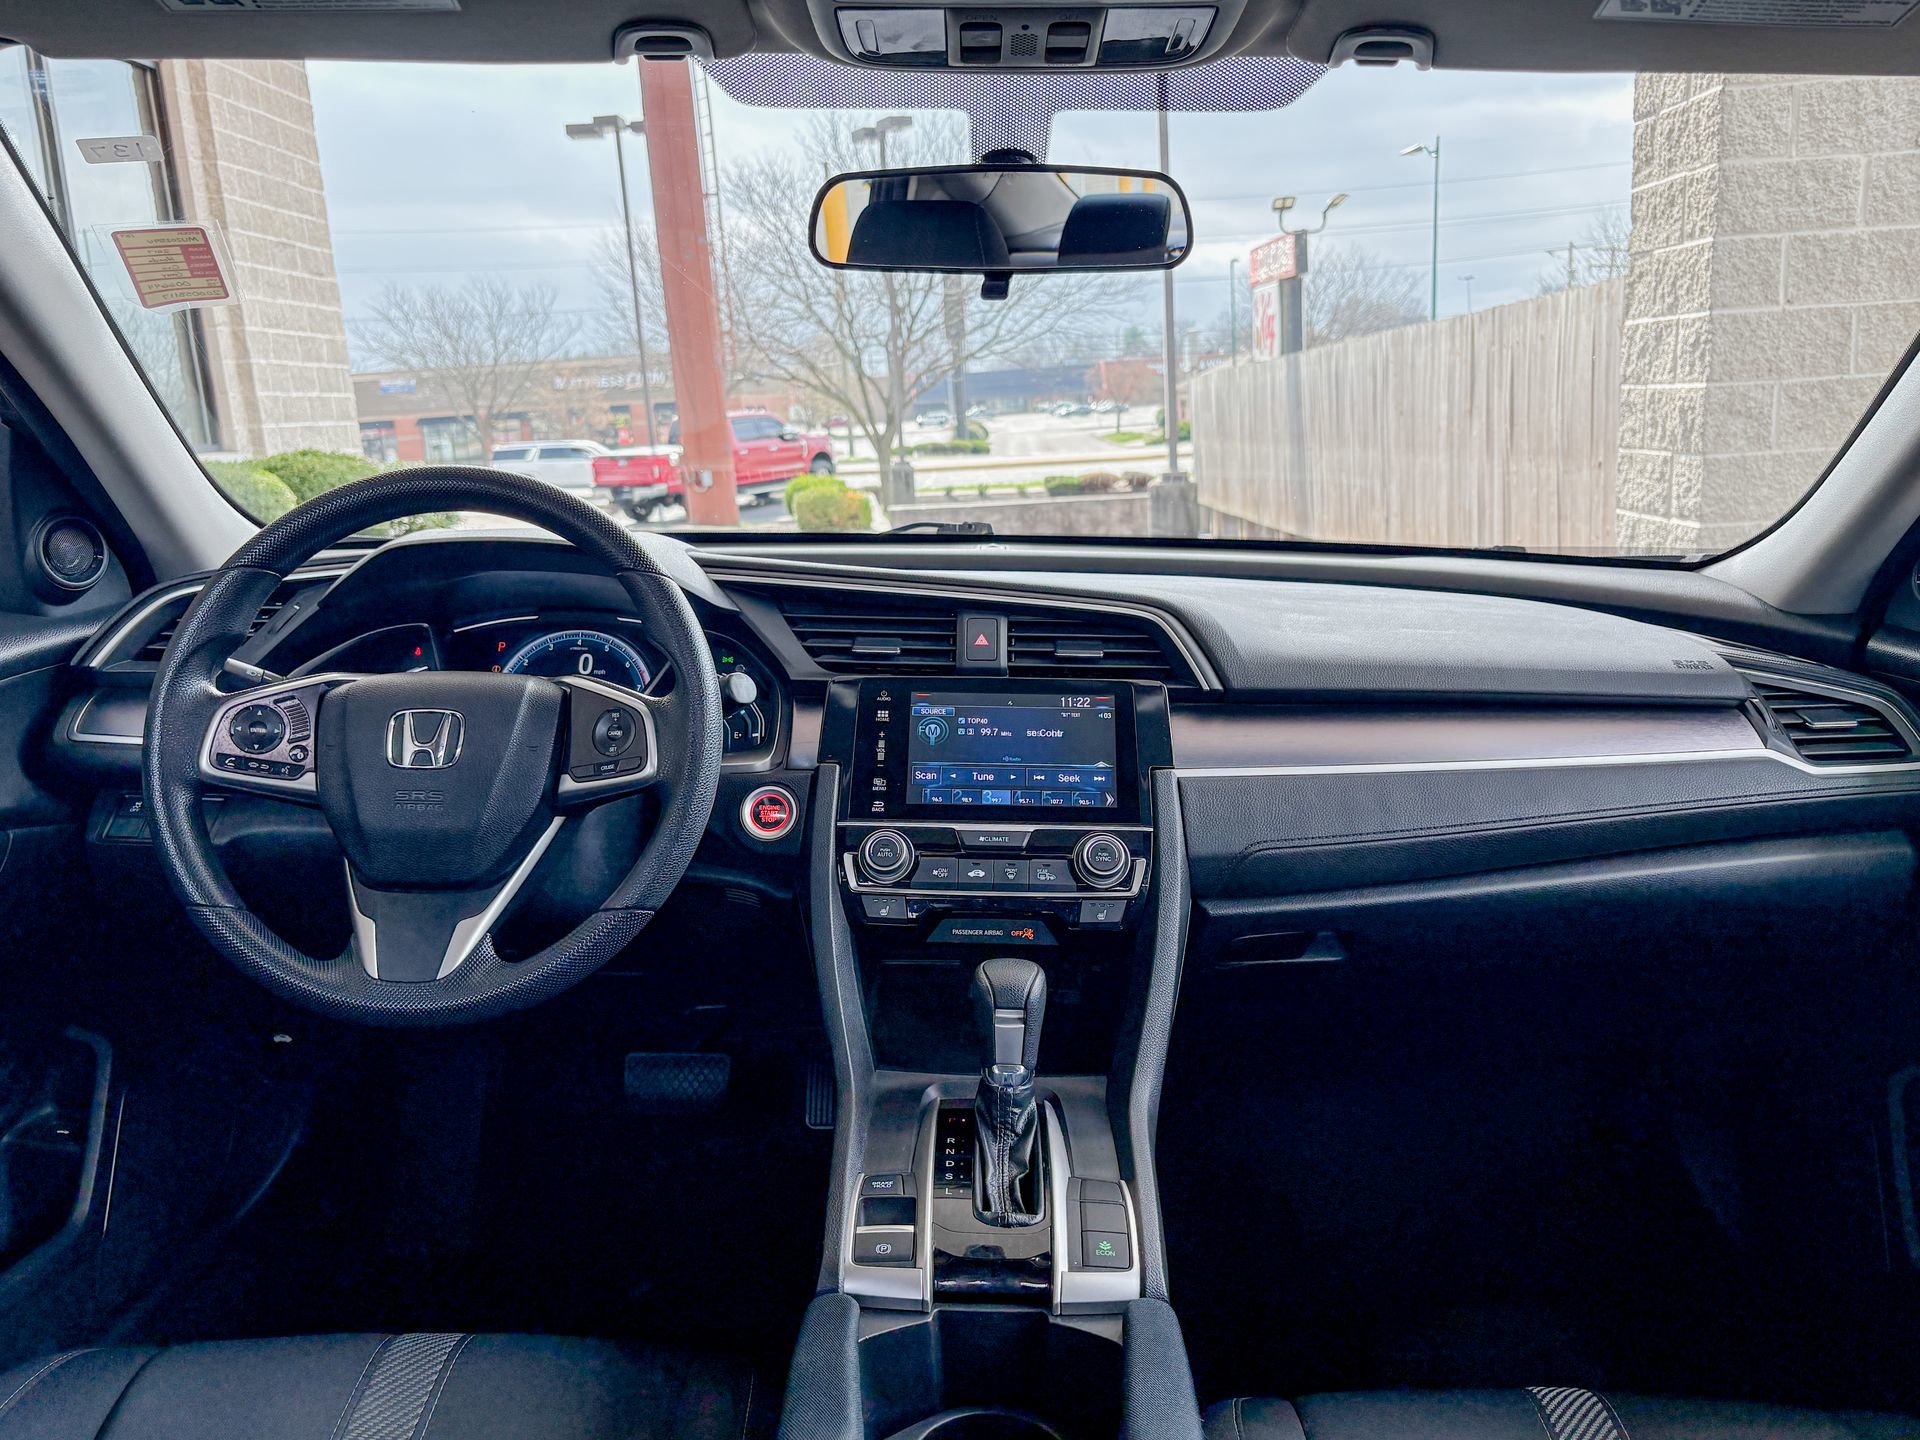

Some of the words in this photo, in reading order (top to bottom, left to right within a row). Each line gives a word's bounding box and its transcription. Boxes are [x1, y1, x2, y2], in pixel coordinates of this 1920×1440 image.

[498, 641, 506, 652] P
[578, 653, 594, 675] 0
[1060, 696, 1091, 708] 11:22
[733, 731, 740, 739] E
[980, 728, 998, 736] 99.7
[915, 771, 937, 780] Scan
[972, 772, 994, 781] Tune
[1058, 773, 1081, 783] Seek
[395, 790, 443, 800] SRS
[952, 928, 983, 936] PASSENGER
[1095, 1249, 1116, 1257] ECON
